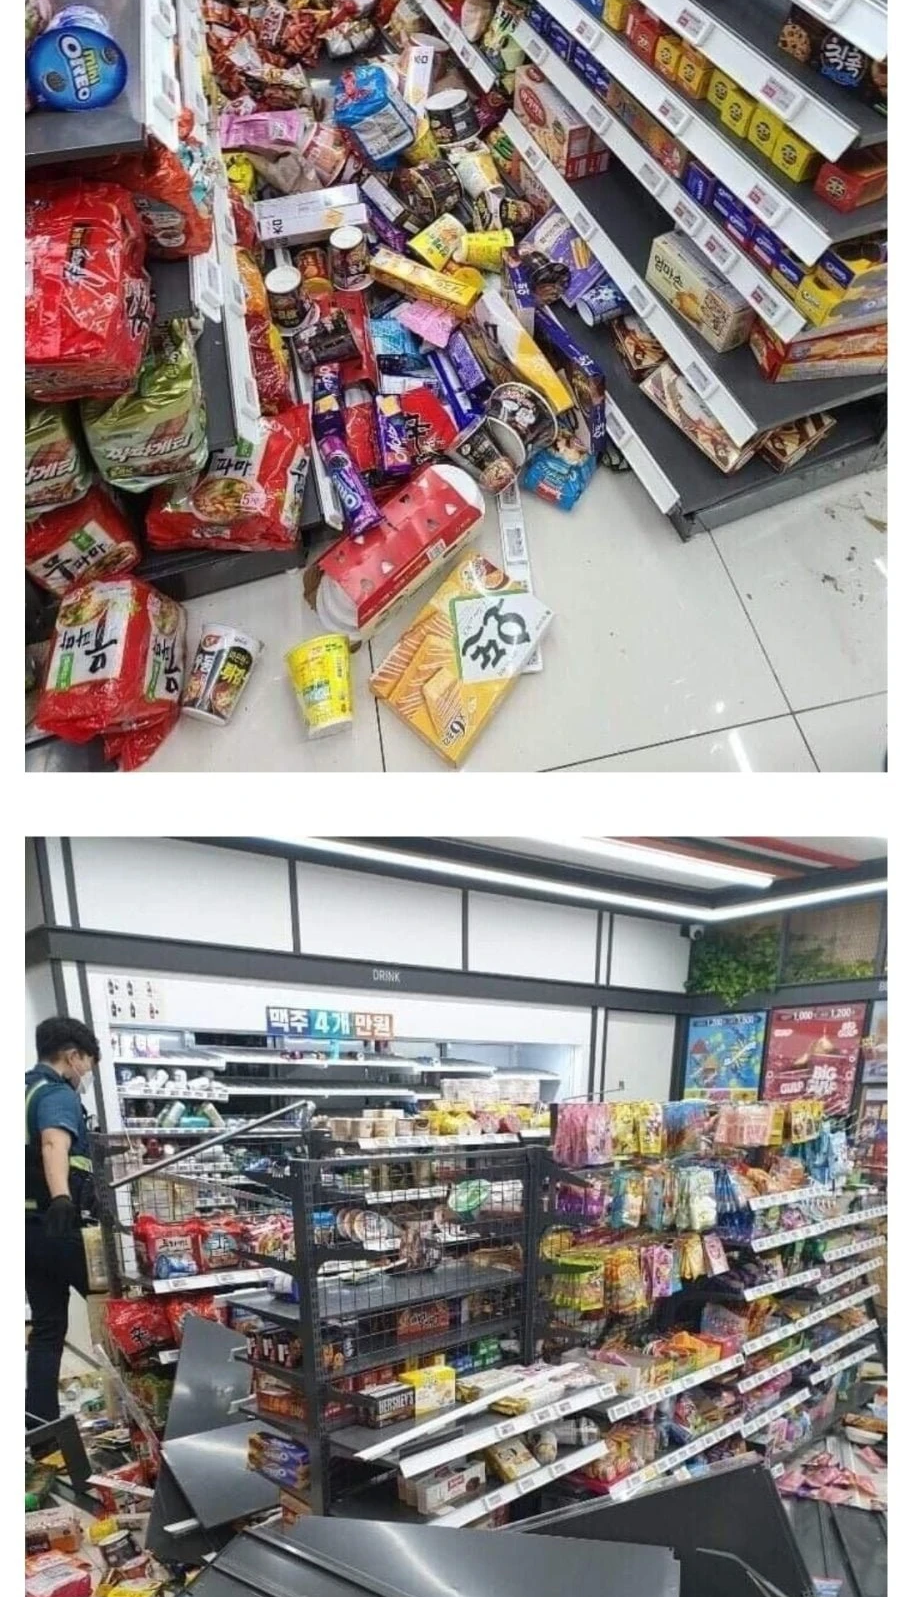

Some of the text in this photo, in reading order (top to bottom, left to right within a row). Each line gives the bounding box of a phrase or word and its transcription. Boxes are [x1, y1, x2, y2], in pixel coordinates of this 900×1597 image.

[59, 34, 92, 102] OREO
[82, 48, 101, 86] mini
[654, 253, 685, 291] 엄마손
[105, 433, 193, 463] 짜파게티
[372, 968, 401, 983] DRINK
[268, 1008, 392, 1037] 맥주 4개 만원
